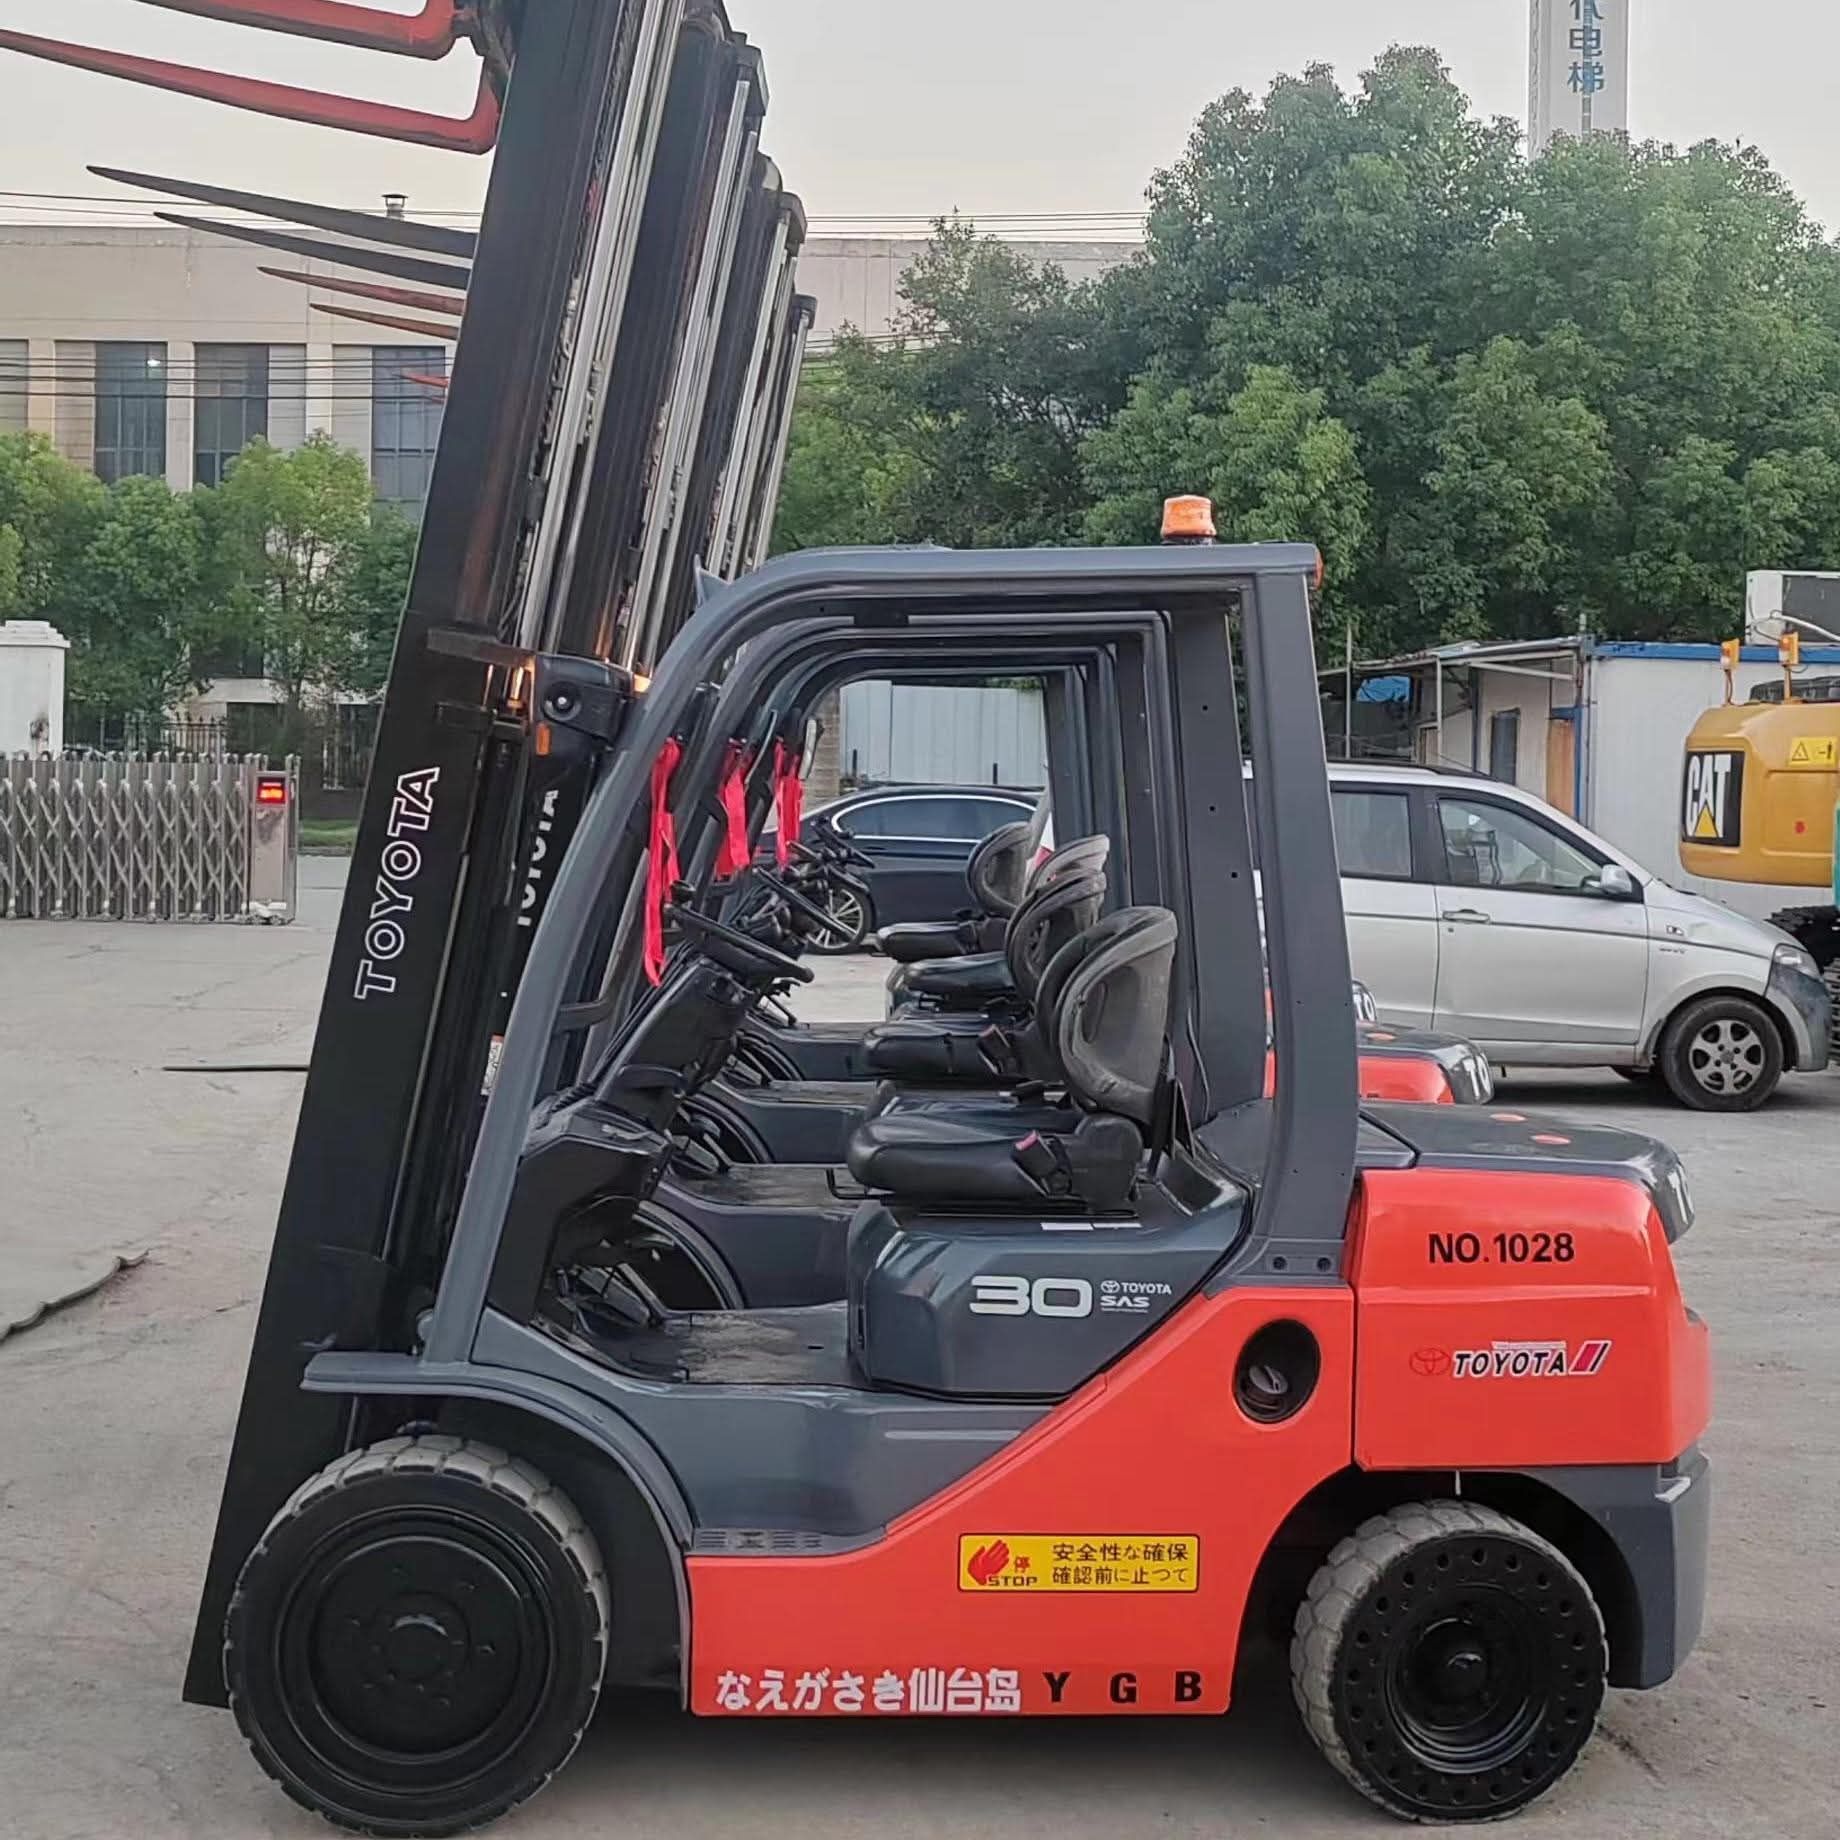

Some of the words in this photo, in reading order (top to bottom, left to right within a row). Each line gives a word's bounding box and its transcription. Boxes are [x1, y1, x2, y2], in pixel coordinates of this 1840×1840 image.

[1686, 754, 1731, 838] CAT
[354, 767, 440, 1000] TOYOTA
[969, 1275, 1093, 1318] 30
[1100, 1295, 1150, 1308] SAS
[1122, 1282, 1171, 1295] TOYOTA
[1452, 1350, 1567, 1377] TOYOTA
[1053, 1543, 1188, 1562] 安全性な確保
[988, 1575, 1038, 1587] STOP
[1042, 1671, 1071, 1703] Y
[1110, 1672, 1137, 1703] G
[1175, 1671, 1202, 1702] B
